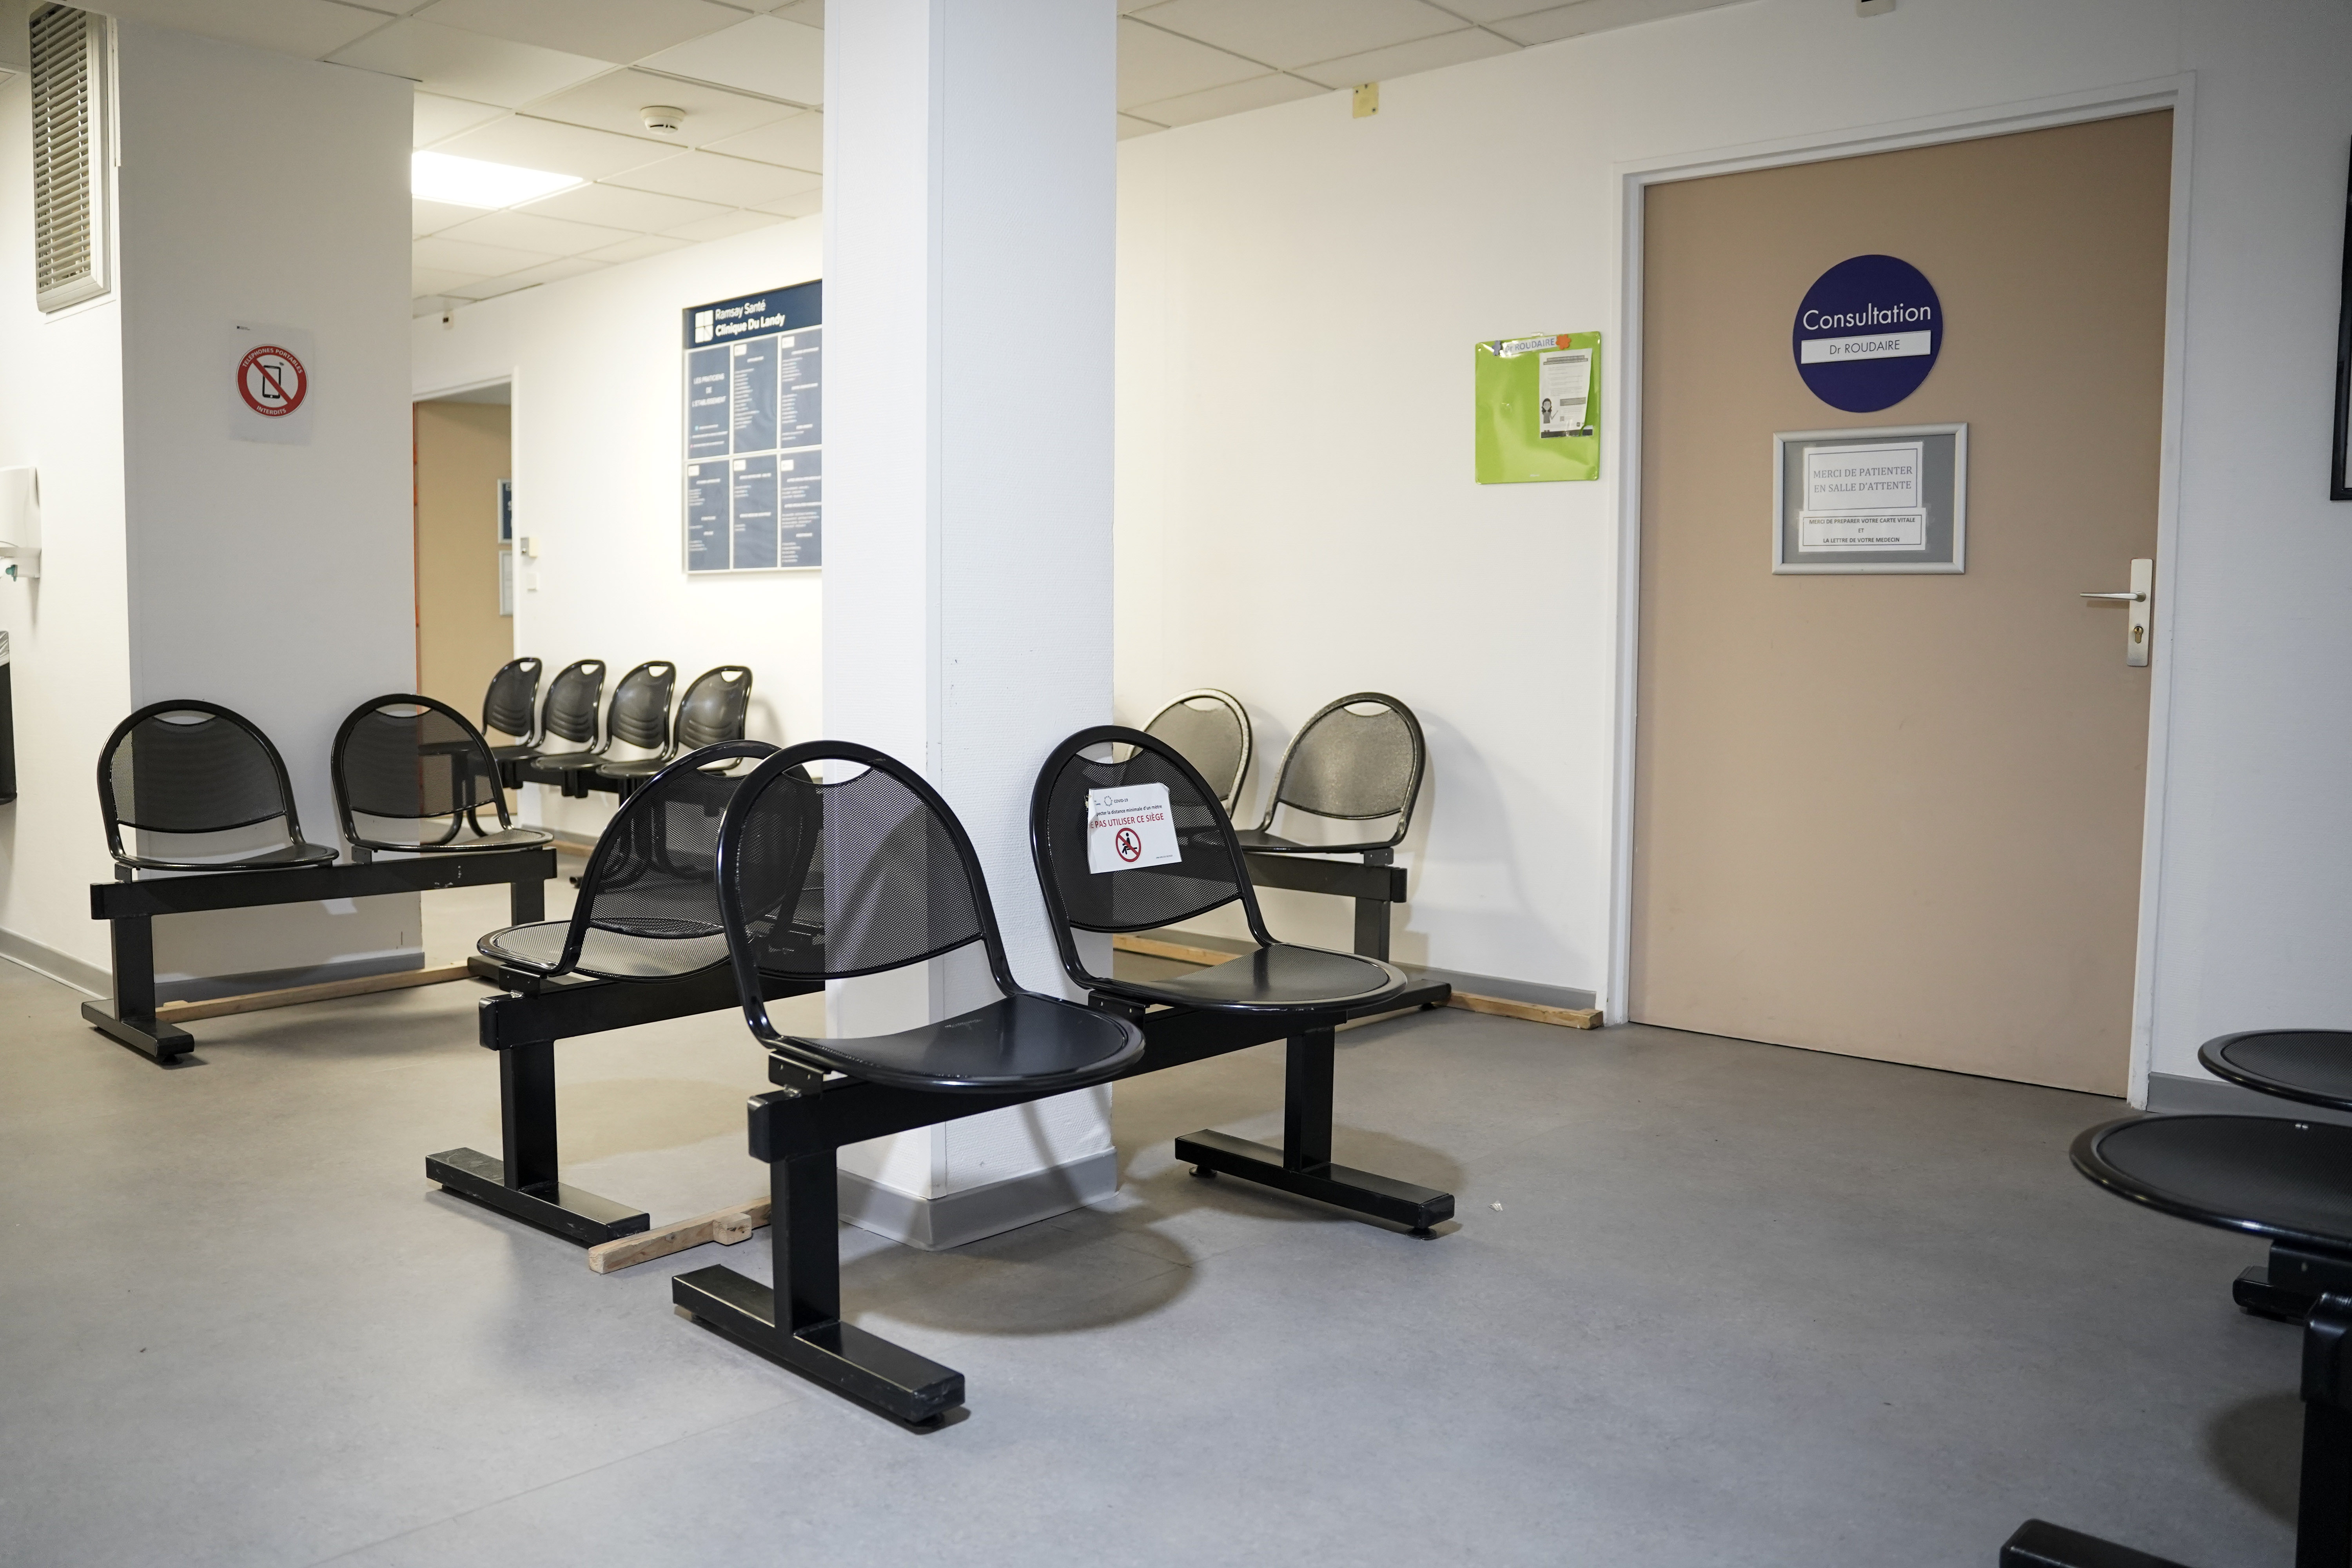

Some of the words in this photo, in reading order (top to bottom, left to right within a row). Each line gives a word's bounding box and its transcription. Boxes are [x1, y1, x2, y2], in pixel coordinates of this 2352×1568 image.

[715, 307, 743, 320] Ramsay
[744, 299, 766, 314] Santé
[1803, 303, 1931, 330] Consultation
[715, 322, 747, 337] Clinique
[748, 318, 760, 330] Du
[760, 313, 785, 327] Landy
[1515, 338, 1555, 351] ROUDAIRE
[1829, 345, 1841, 355] Dr
[1845, 340, 1900, 353] ROUDAIRE
[242, 348, 274, 367] TELEPHONES
[275, 348, 303, 374] PORTABLES
[256, 405, 287, 415] INTERDITS
[1845, 469, 1857, 477] DE
[1859, 466, 1913, 477] PATIENTER
[1814, 485, 1826, 493] EN
[1828, 483, 1856, 492] SALLE
[1859, 481, 1912, 491] D'ATTENTE
[1108, 817, 1135, 826] UTILISER
[1146, 812, 1164, 821] SIÈGE
